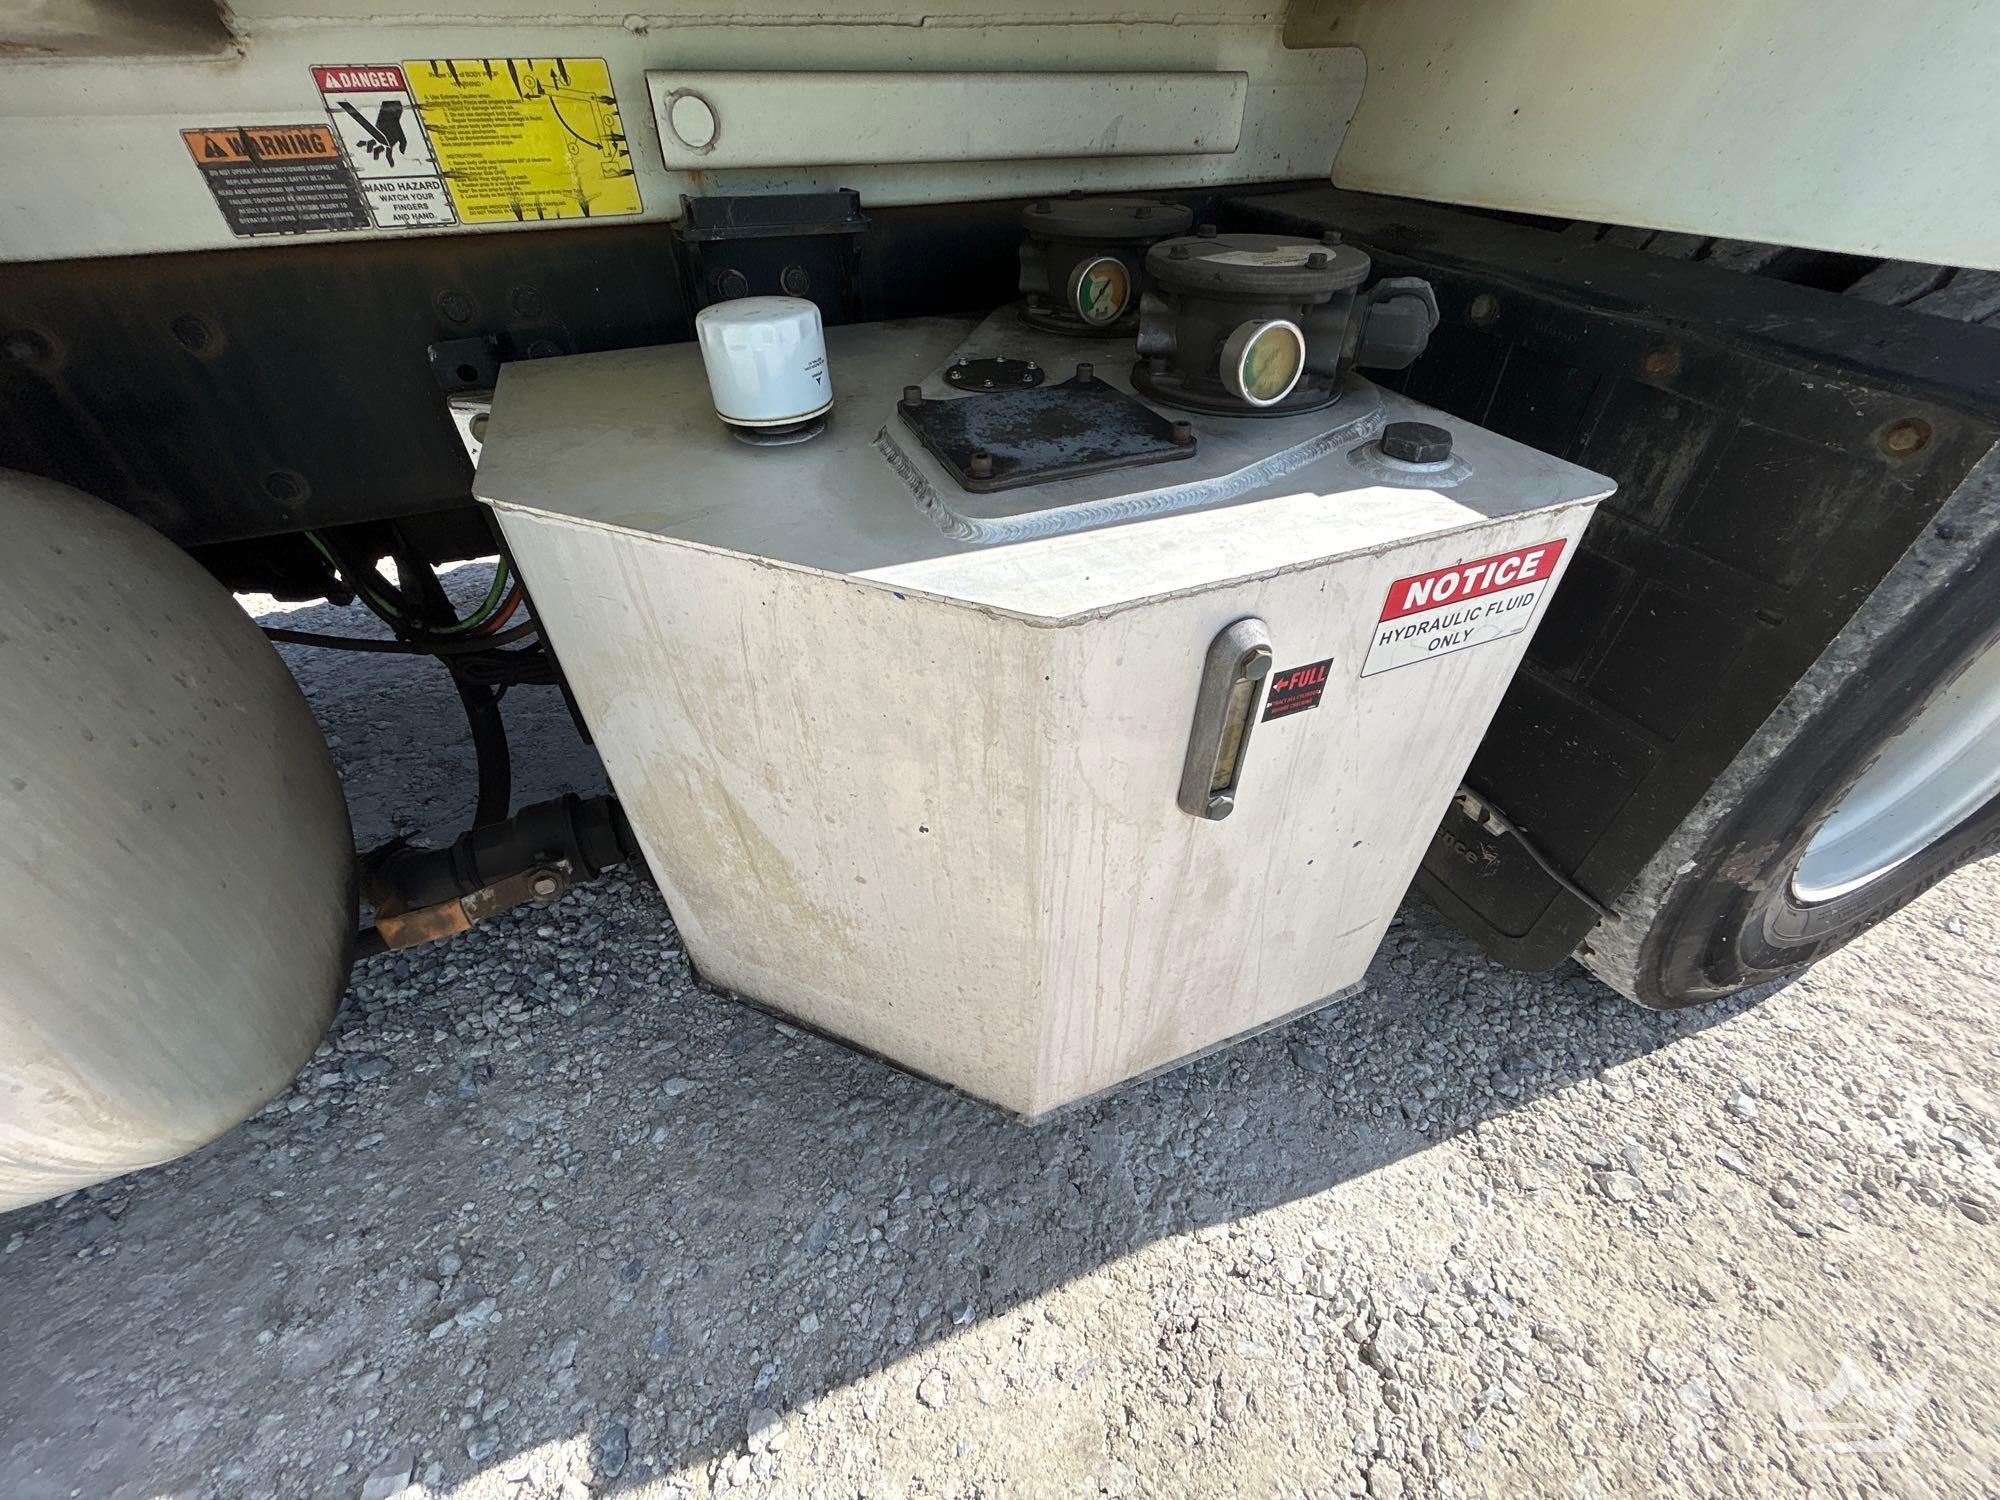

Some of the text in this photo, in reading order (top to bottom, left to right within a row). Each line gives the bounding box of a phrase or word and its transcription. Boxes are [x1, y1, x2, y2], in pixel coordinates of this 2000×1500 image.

[339, 72, 399, 88] DANGER
[364, 181, 440, 192] HAND HAZARD
[379, 194, 409, 202] WATCH
[393, 203, 429, 211] FINGERS
[1402, 550, 1545, 610] NOTICE
[1379, 592, 1535, 646] HYDRAULIC FLUID
[1428, 627, 1474, 651] ONLY
[1289, 665, 1325, 690] FULL
